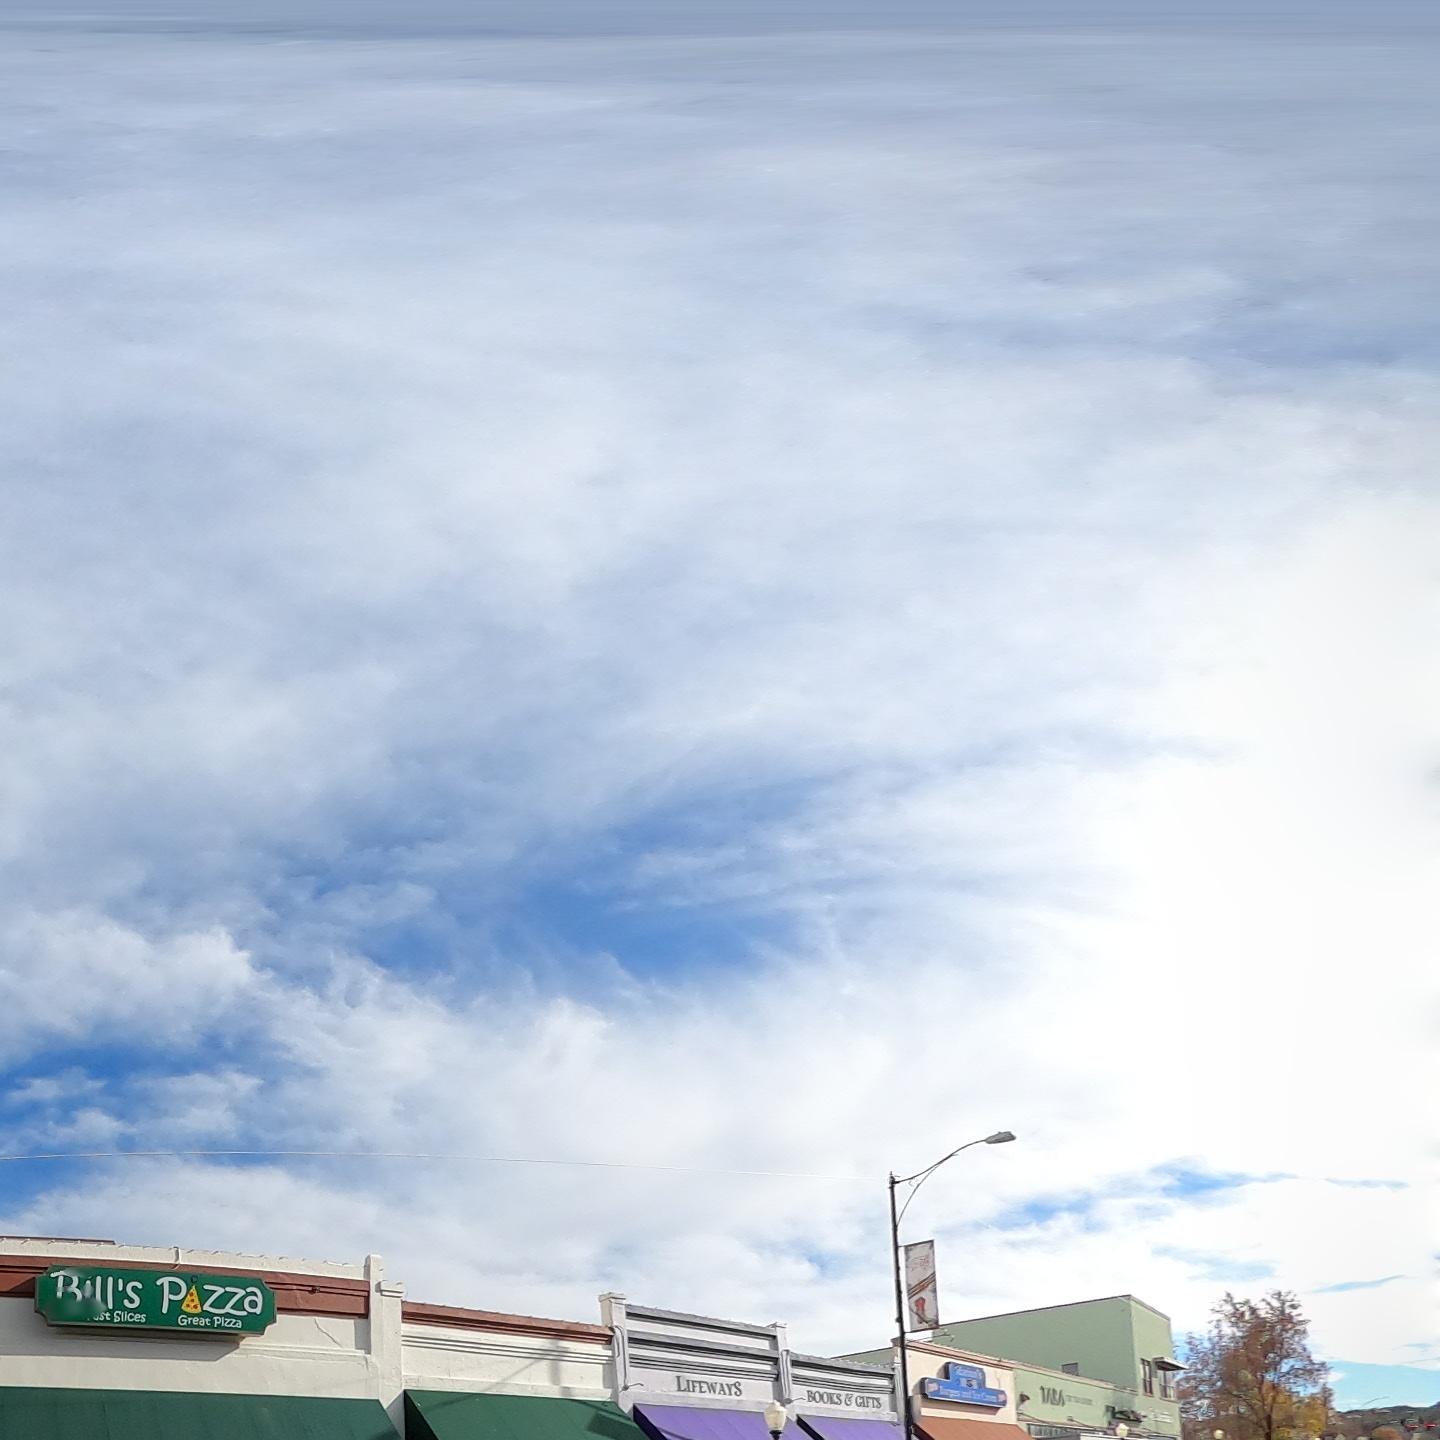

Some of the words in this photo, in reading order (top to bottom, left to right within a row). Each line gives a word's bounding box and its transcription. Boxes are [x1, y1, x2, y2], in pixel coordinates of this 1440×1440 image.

[113, 1310, 147, 1324] Slices
[177, 1314, 212, 1327] Great
[213, 1315, 243, 1329] Pizza
[806, 1390, 842, 1406] BOOKS
[844, 1393, 854, 1407] &
[855, 1394, 882, 1409] GIFTS
